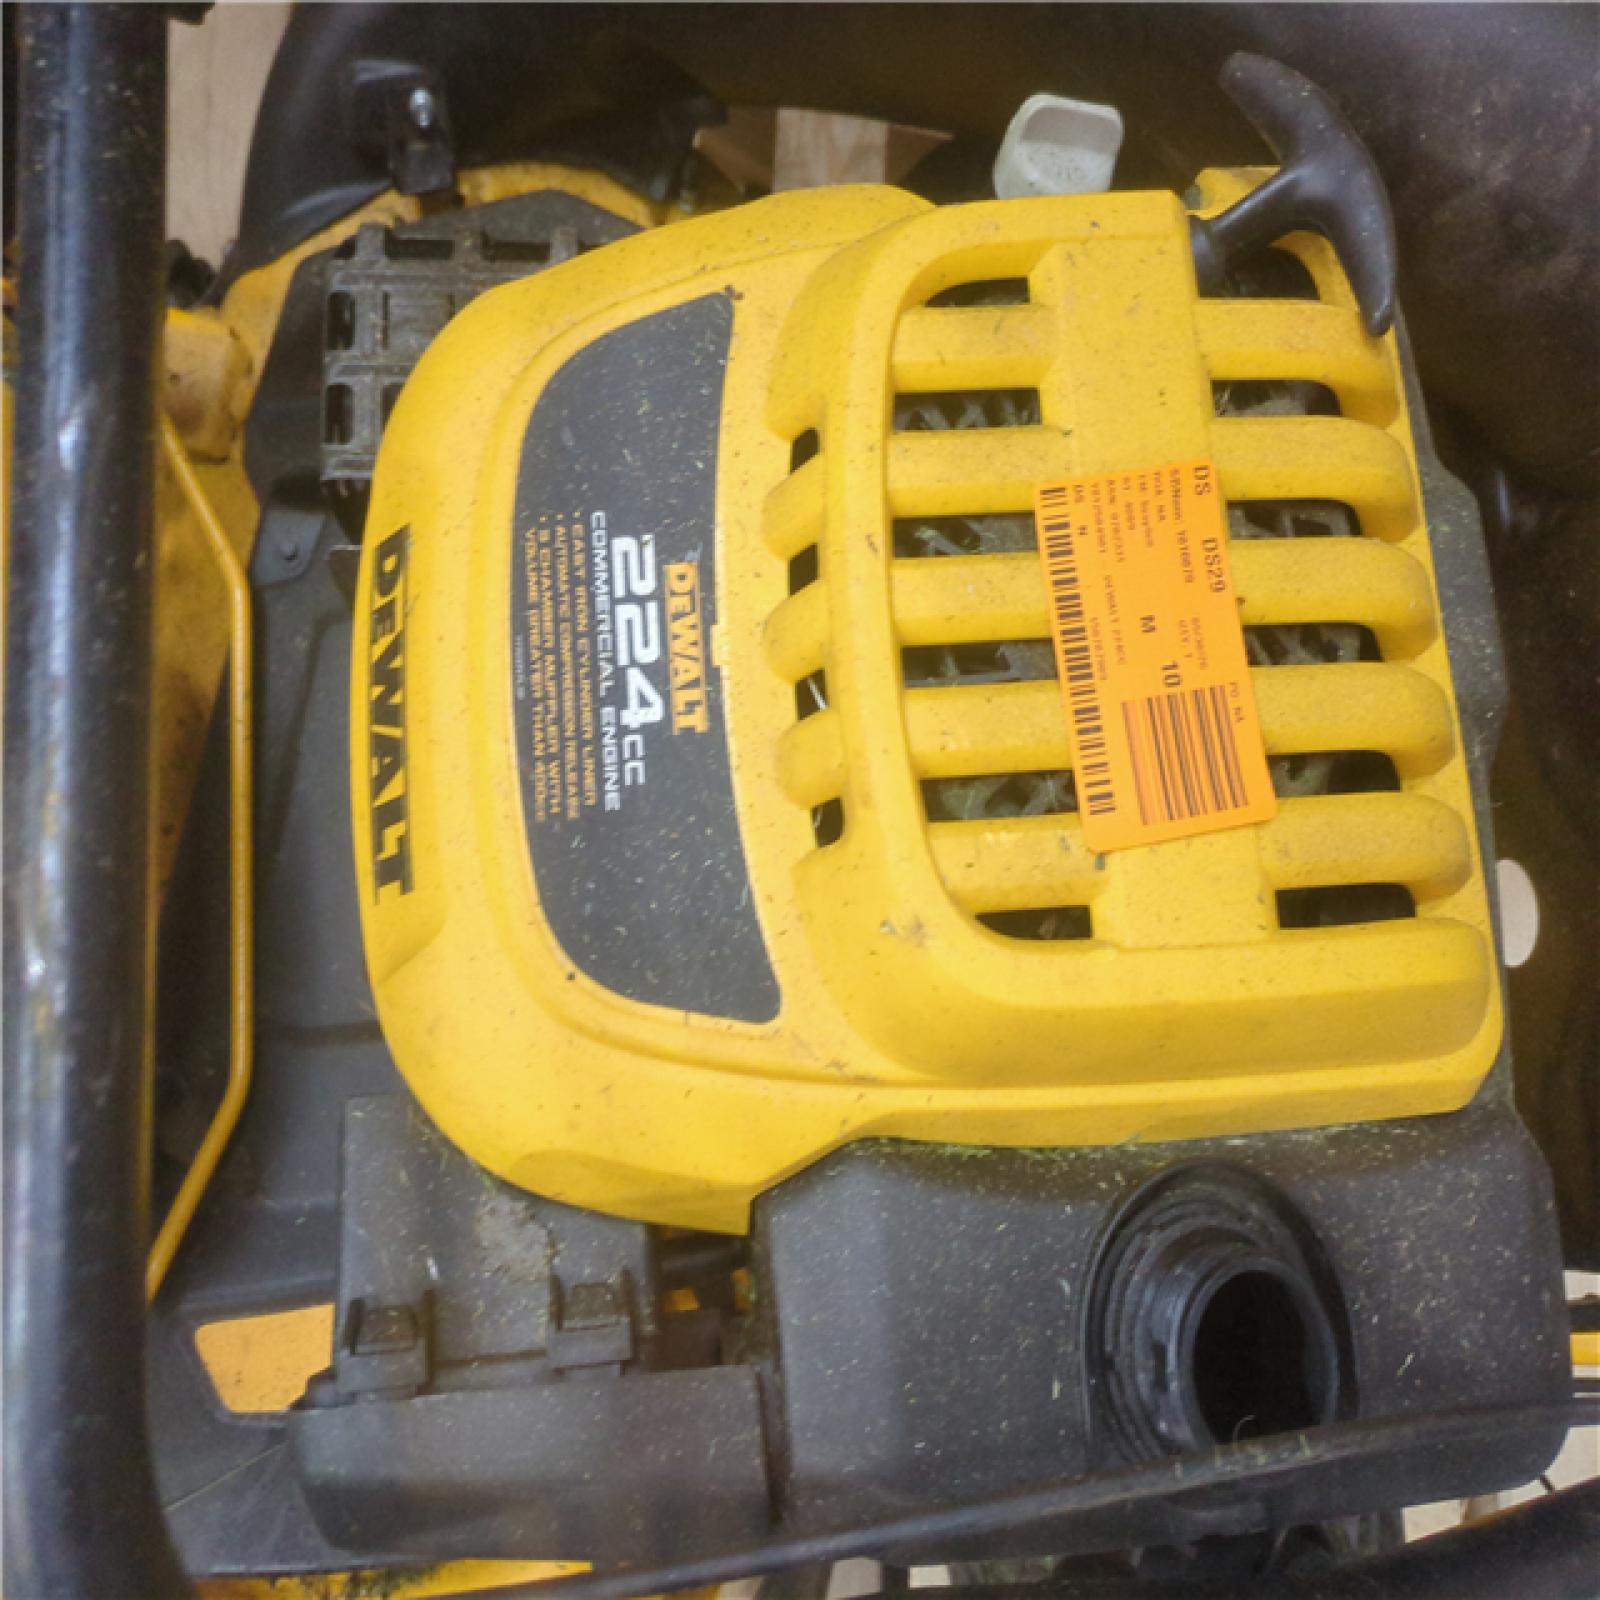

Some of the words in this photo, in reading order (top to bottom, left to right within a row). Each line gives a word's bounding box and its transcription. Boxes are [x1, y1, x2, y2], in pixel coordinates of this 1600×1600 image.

[1194, 465, 1211, 496] DS
[525, 527, 540, 603] VOLUME
[540, 546, 555, 648] CHAMBER
[554, 524, 571, 618] AUTOMATIC
[590, 511, 615, 697] COMMERCIAL
[1202, 537, 1226, 593] DS29
[574, 584, 588, 631] IRON
[662, 560, 709, 735] DEWALT
[1139, 614, 1157, 633] M
[528, 609, 543, 698] GREATER
[576, 637, 593, 740] CYLINDER
[1160, 660, 1182, 687] 10
[369, 523, 415, 905] DEWALT
[532, 702, 545, 756] THAN
[543, 654, 560, 753] MUFFLER
[548, 759, 561, 813] WITH
[582, 744, 597, 806] LINER
[600, 706, 621, 811] ENGINE
